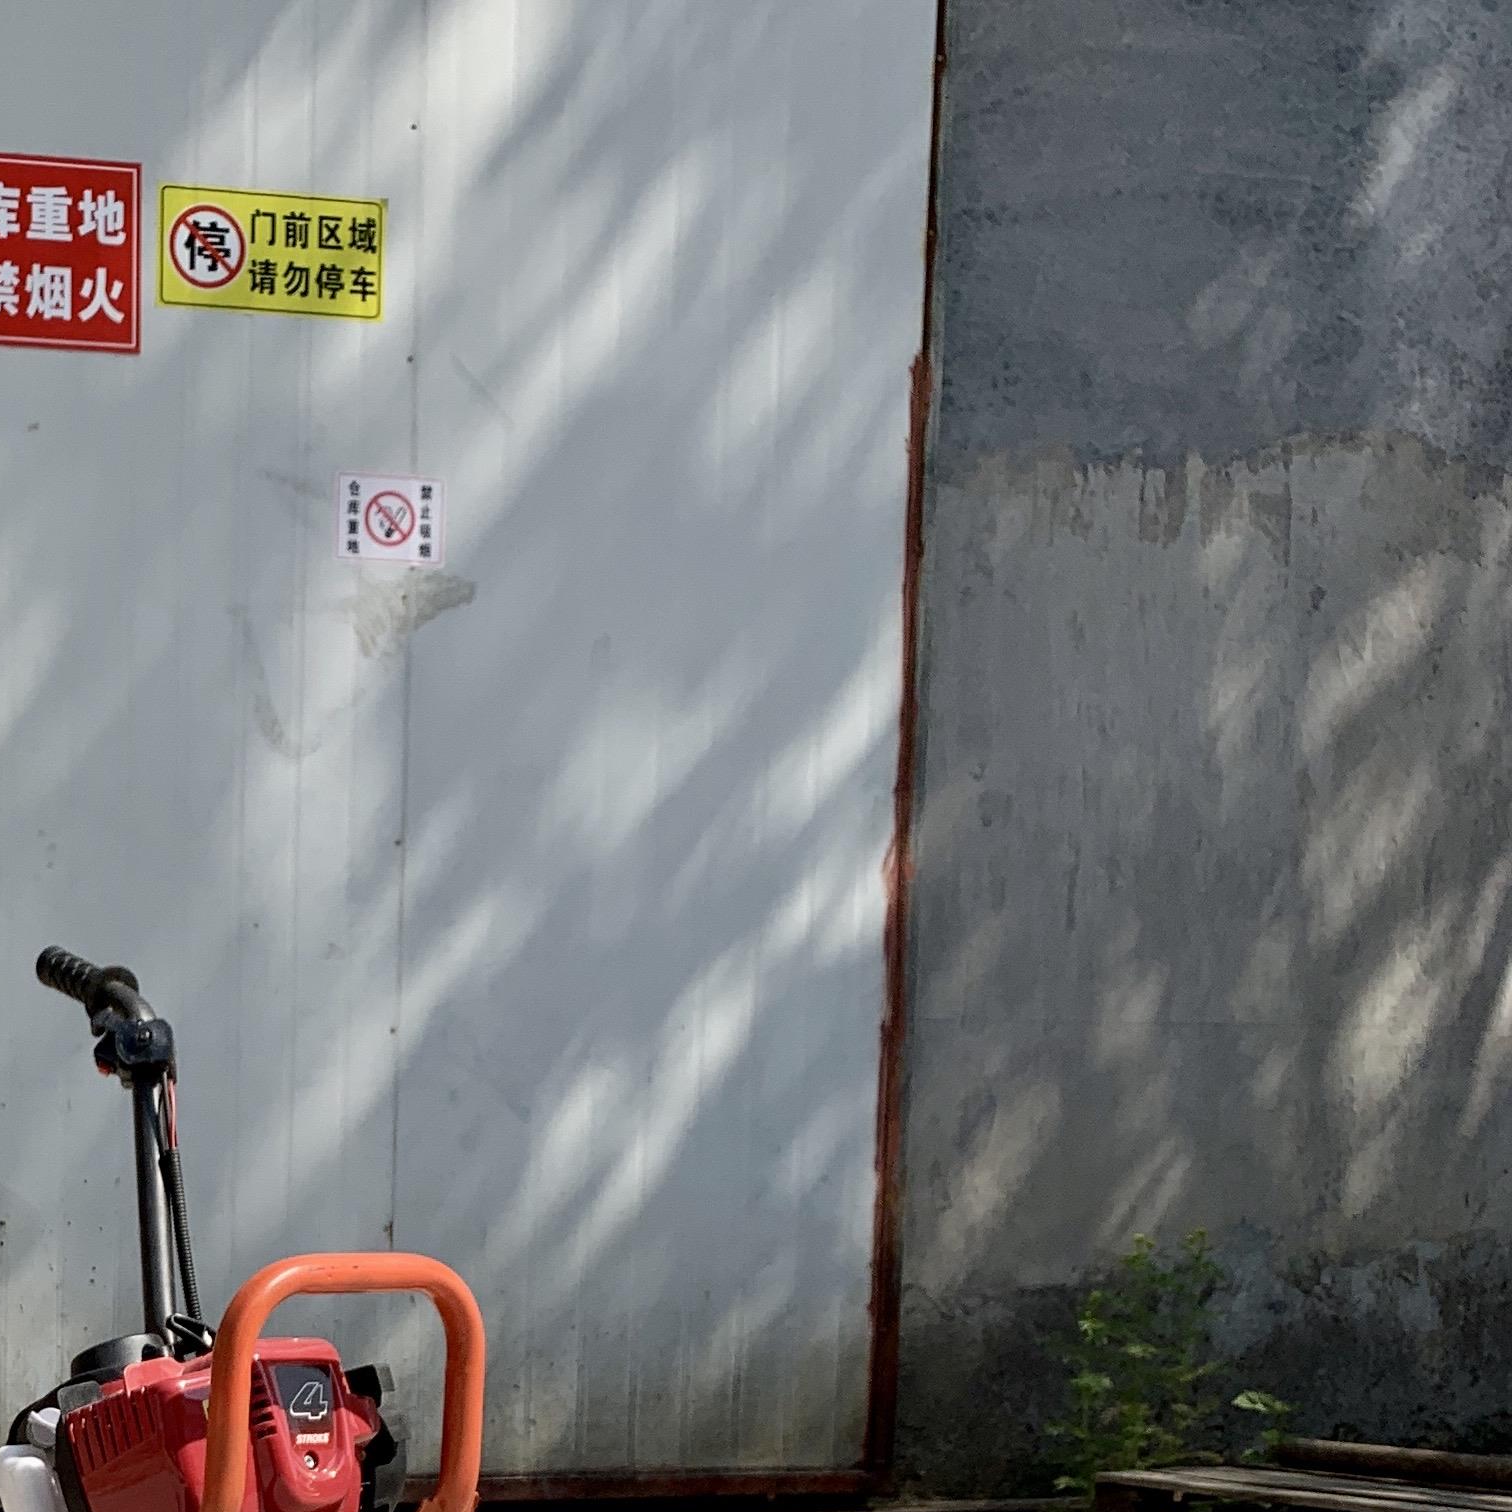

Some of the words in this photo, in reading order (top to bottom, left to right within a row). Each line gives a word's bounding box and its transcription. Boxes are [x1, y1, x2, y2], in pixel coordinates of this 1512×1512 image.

[184, 219, 232, 273] 停
[249, 208, 378, 254] 门前区域
[248, 258, 378, 302] 请勿停车
[347, 480, 360, 554] 仓库重地
[419, 485, 432, 558] 禁止吸烟
[289, 1381, 329, 1420] 4
[295, 1432, 331, 1446] STROKE
